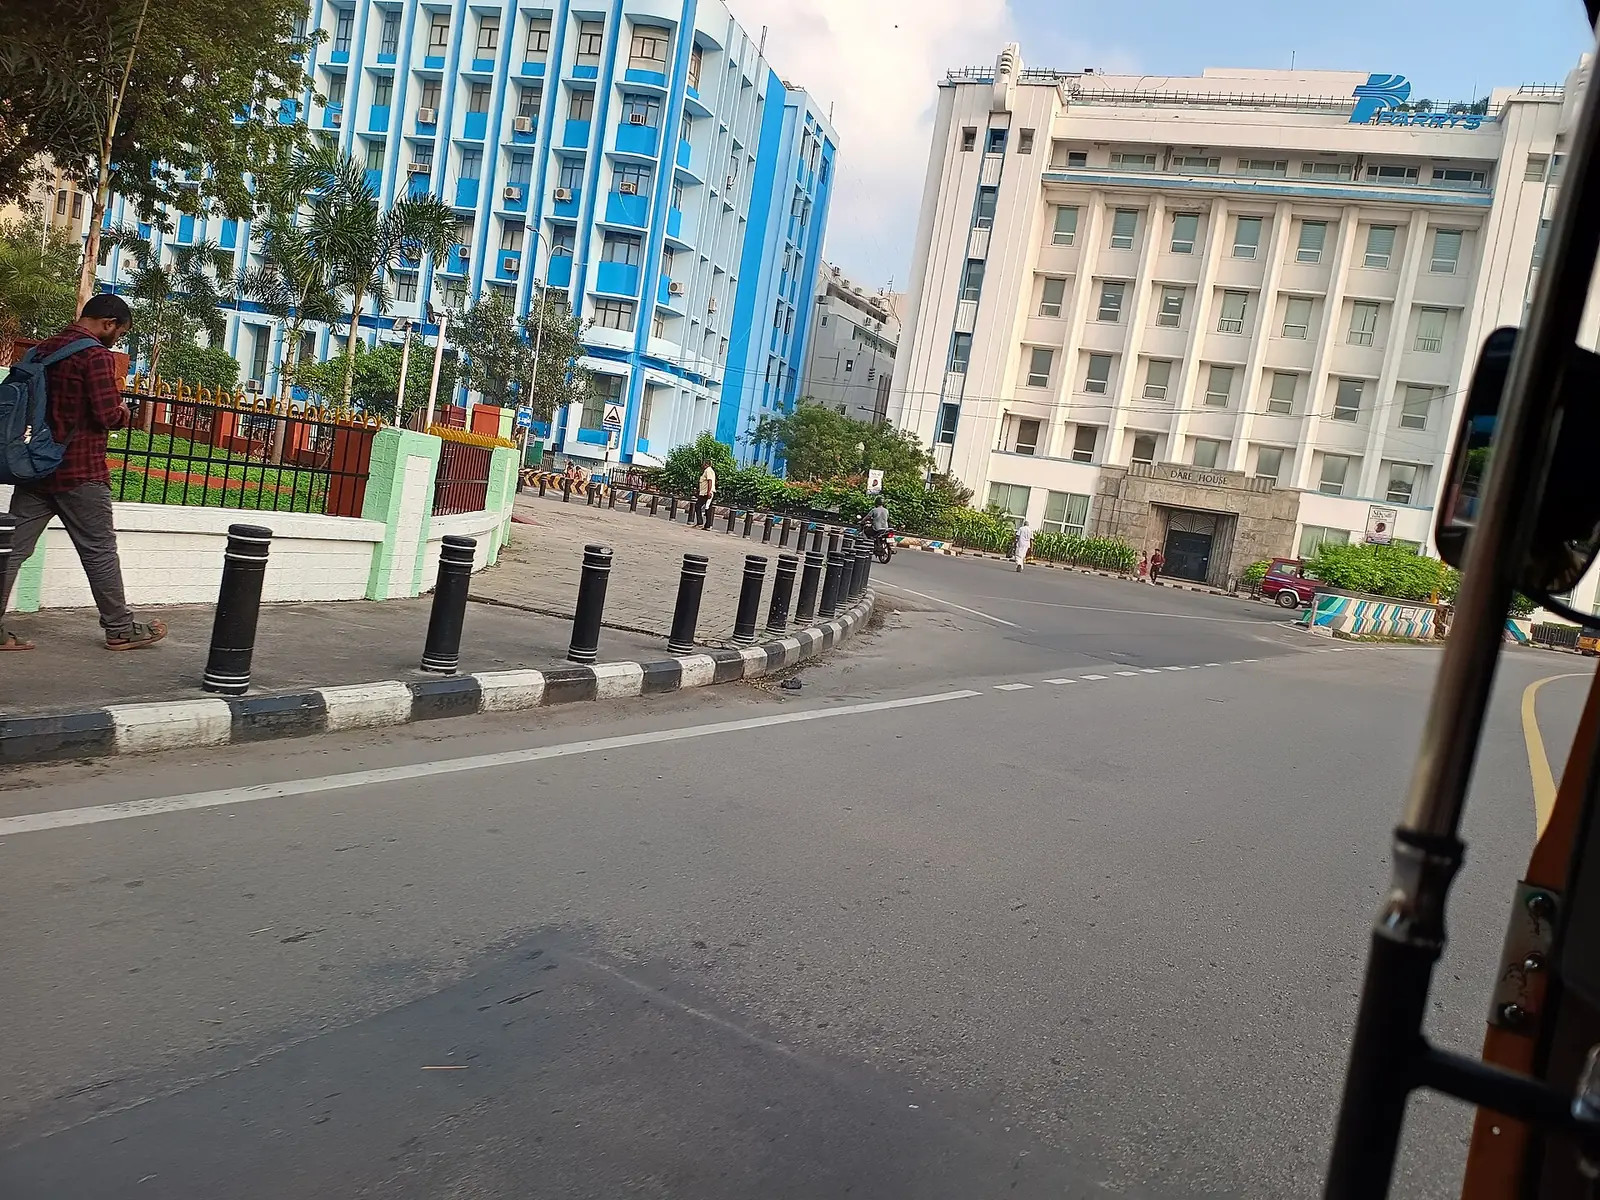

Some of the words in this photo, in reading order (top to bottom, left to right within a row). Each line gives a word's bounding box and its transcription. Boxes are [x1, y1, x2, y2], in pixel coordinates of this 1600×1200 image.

[1378, 111, 1483, 130] PARRYS
[1170, 470, 1192, 481] DARE
[1198, 474, 1228, 485] HOUSE
